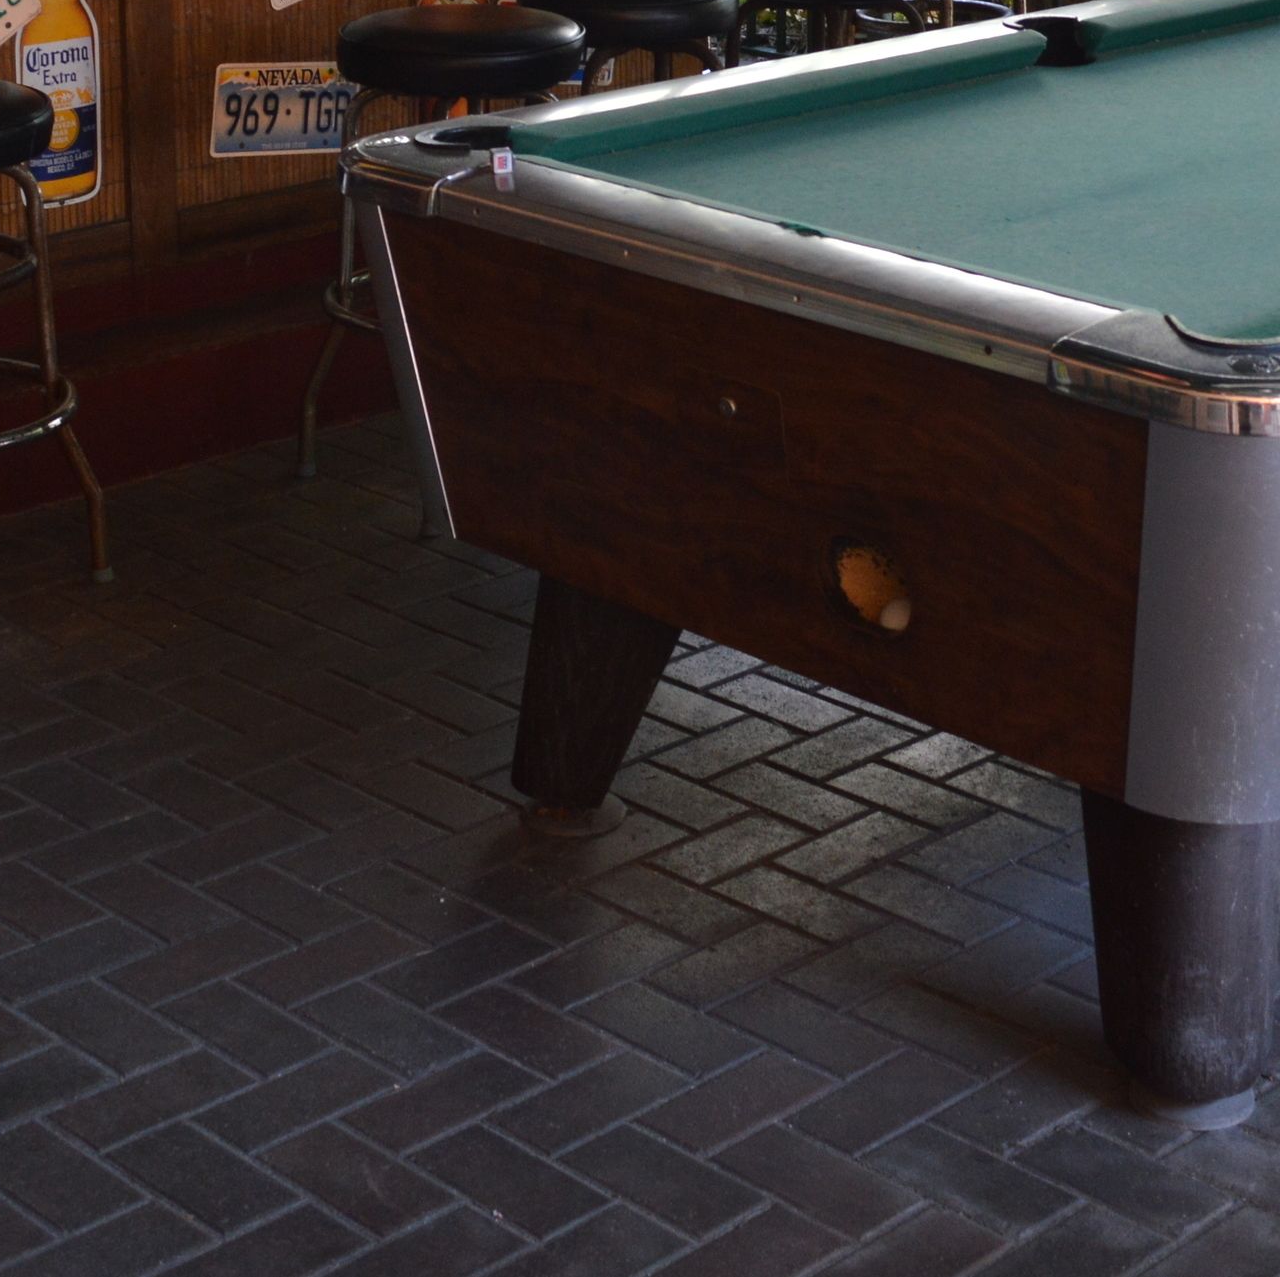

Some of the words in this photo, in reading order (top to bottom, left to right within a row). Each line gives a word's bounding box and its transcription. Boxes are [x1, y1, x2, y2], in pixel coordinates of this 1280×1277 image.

[26, 44, 90, 75] Corona
[42, 68, 77, 86] Extra
[256, 68, 322, 86] NEVADA
[225, 91, 280, 136] 969
